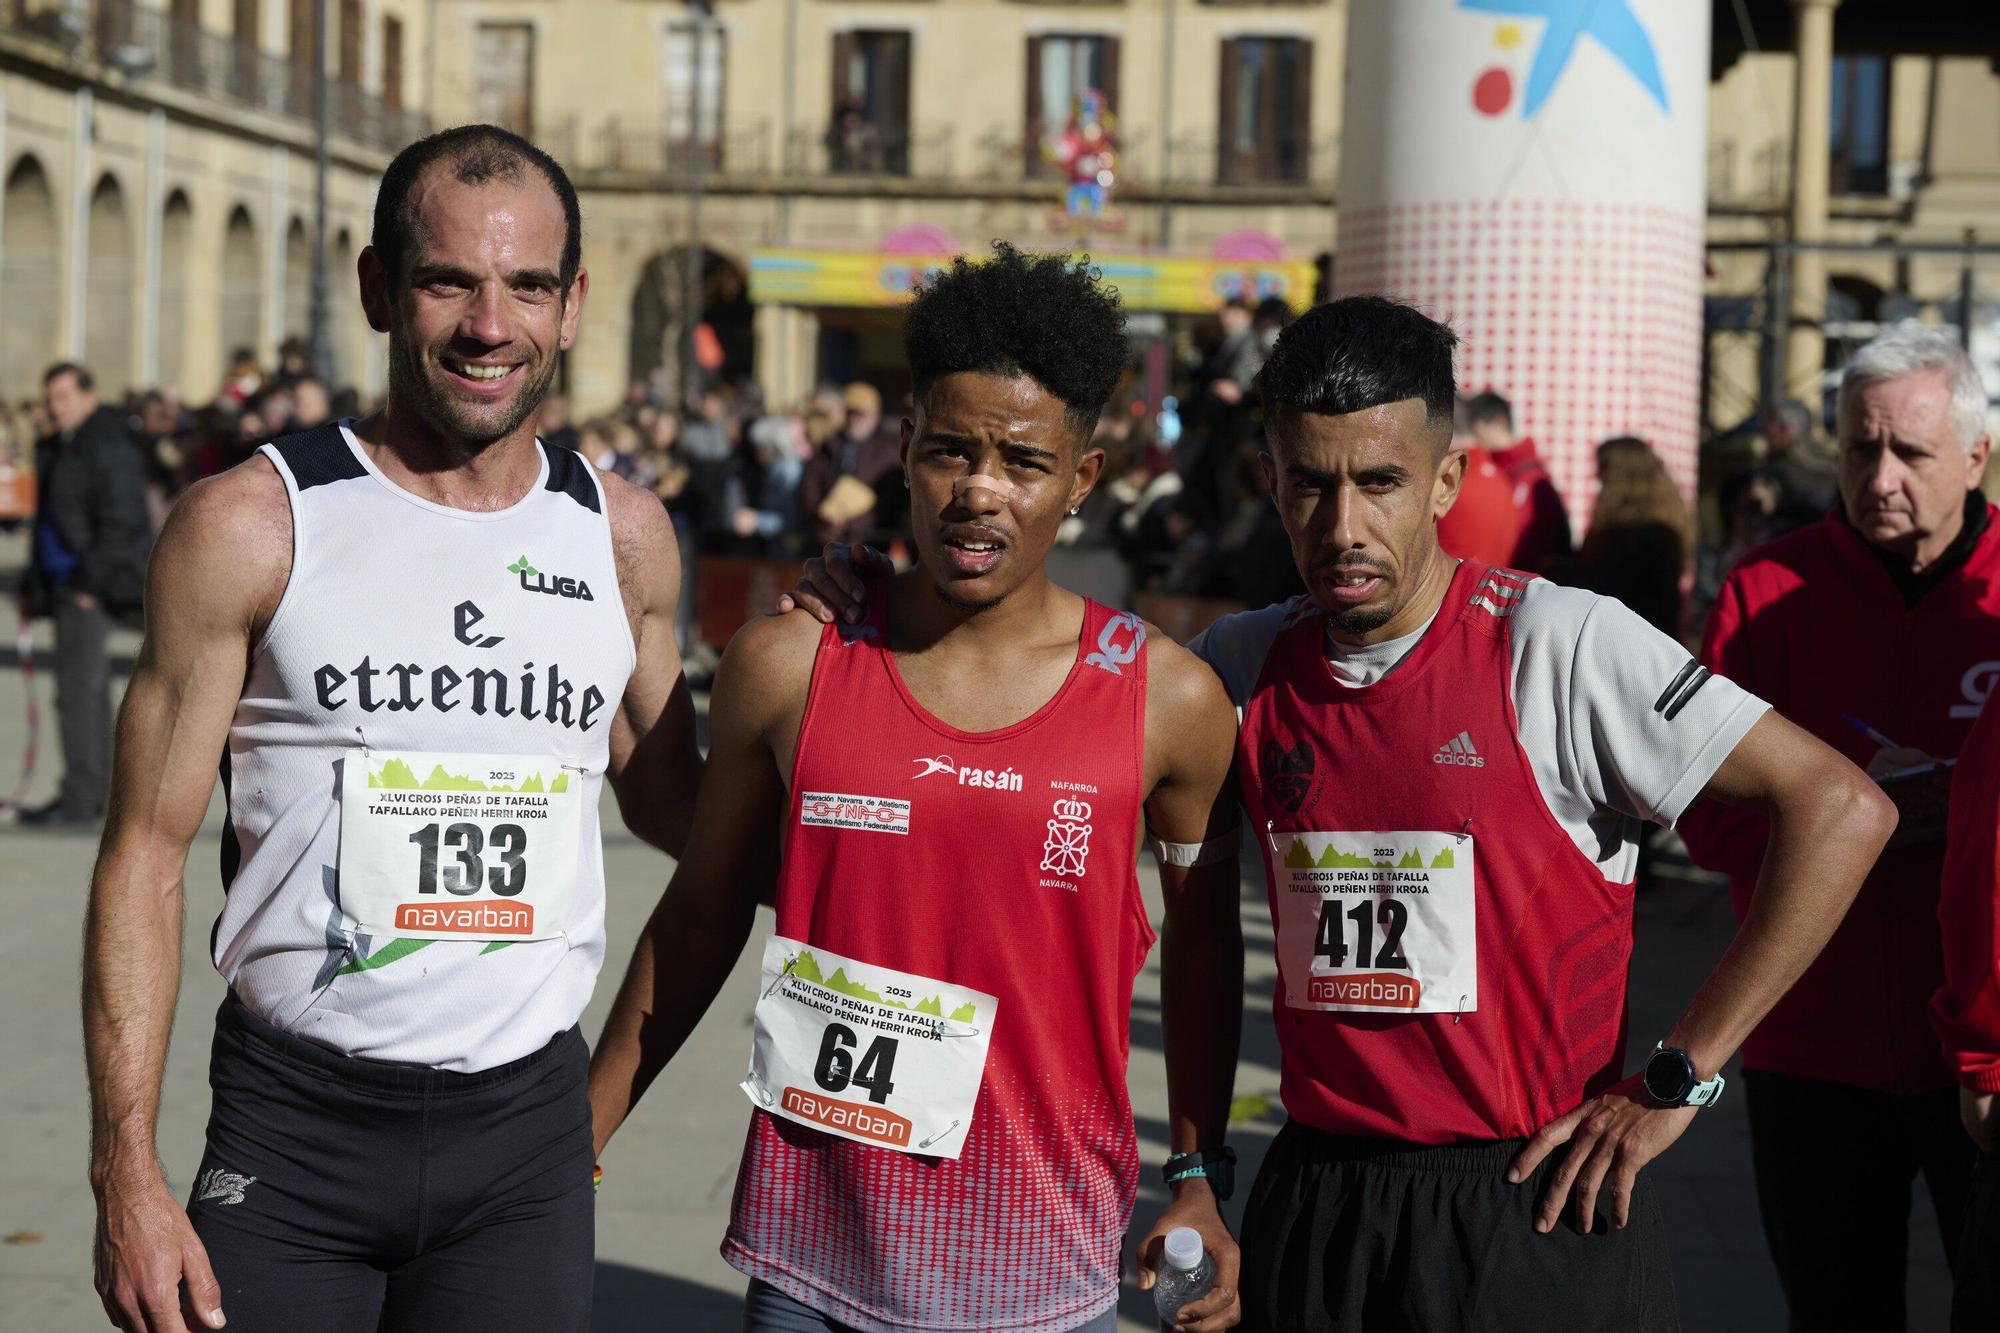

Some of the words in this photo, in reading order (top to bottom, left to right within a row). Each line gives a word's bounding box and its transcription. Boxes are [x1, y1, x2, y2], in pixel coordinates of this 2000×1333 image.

[520, 569, 594, 601] LUGA
[314, 655, 605, 732] etxenike
[1433, 752, 1485, 767] adidas
[489, 771, 515, 780] 2025
[959, 767, 1023, 792] rasán
[1051, 780, 1098, 794] NAFARROA
[380, 793, 406, 803] XLVI
[408, 793, 442, 804] CROSS
[446, 793, 482, 805] PEÑAS
[486, 796, 501, 805] DE
[504, 796, 549, 806] TAFALLA
[804, 794, 834, 802] Federación
[878, 800, 909, 810] Atletismo
[369, 805, 437, 817] TAFALLAKO
[440, 806, 478, 818] PEÑEN
[481, 808, 513, 818] HERRI
[516, 809, 548, 819] KROSA
[834, 818, 862, 828] Atletismo
[863, 821, 908, 832] Federakuntza
[409, 822, 527, 896] 133
[1373, 848, 1395, 857] 2025
[1292, 872, 1308, 881] XLVI
[1308, 872, 1334, 881] CROSS
[1337, 871, 1369, 881] PEÑAS
[1372, 872, 1384, 881] DE
[1387, 872, 1429, 882] TAFALLA
[1040, 879, 1078, 893] NAVARRA
[1288, 884, 1330, 893] TAFALLAKO
[1332, 883, 1366, 894] PEÑEN
[1368, 885, 1394, 893] HERRI
[1396, 885, 1429, 894] KROSA
[404, 905, 528, 928] navarban
[1314, 899, 1408, 969] 412
[885, 985, 912, 999] 2025
[1311, 978, 1413, 1001] navarban
[791, 979, 812, 993] XLVI
[811, 987, 839, 1004] CROSS
[841, 997, 875, 1015] PEÑAS
[878, 1008, 893, 1019] DE
[781, 988, 833, 1014] TAFALLAKO
[834, 1007, 869, 1025] PEÑEN
[871, 1019, 904, 1034] HERRI
[813, 1022, 899, 1105] 64
[787, 1092, 904, 1140] navarban
